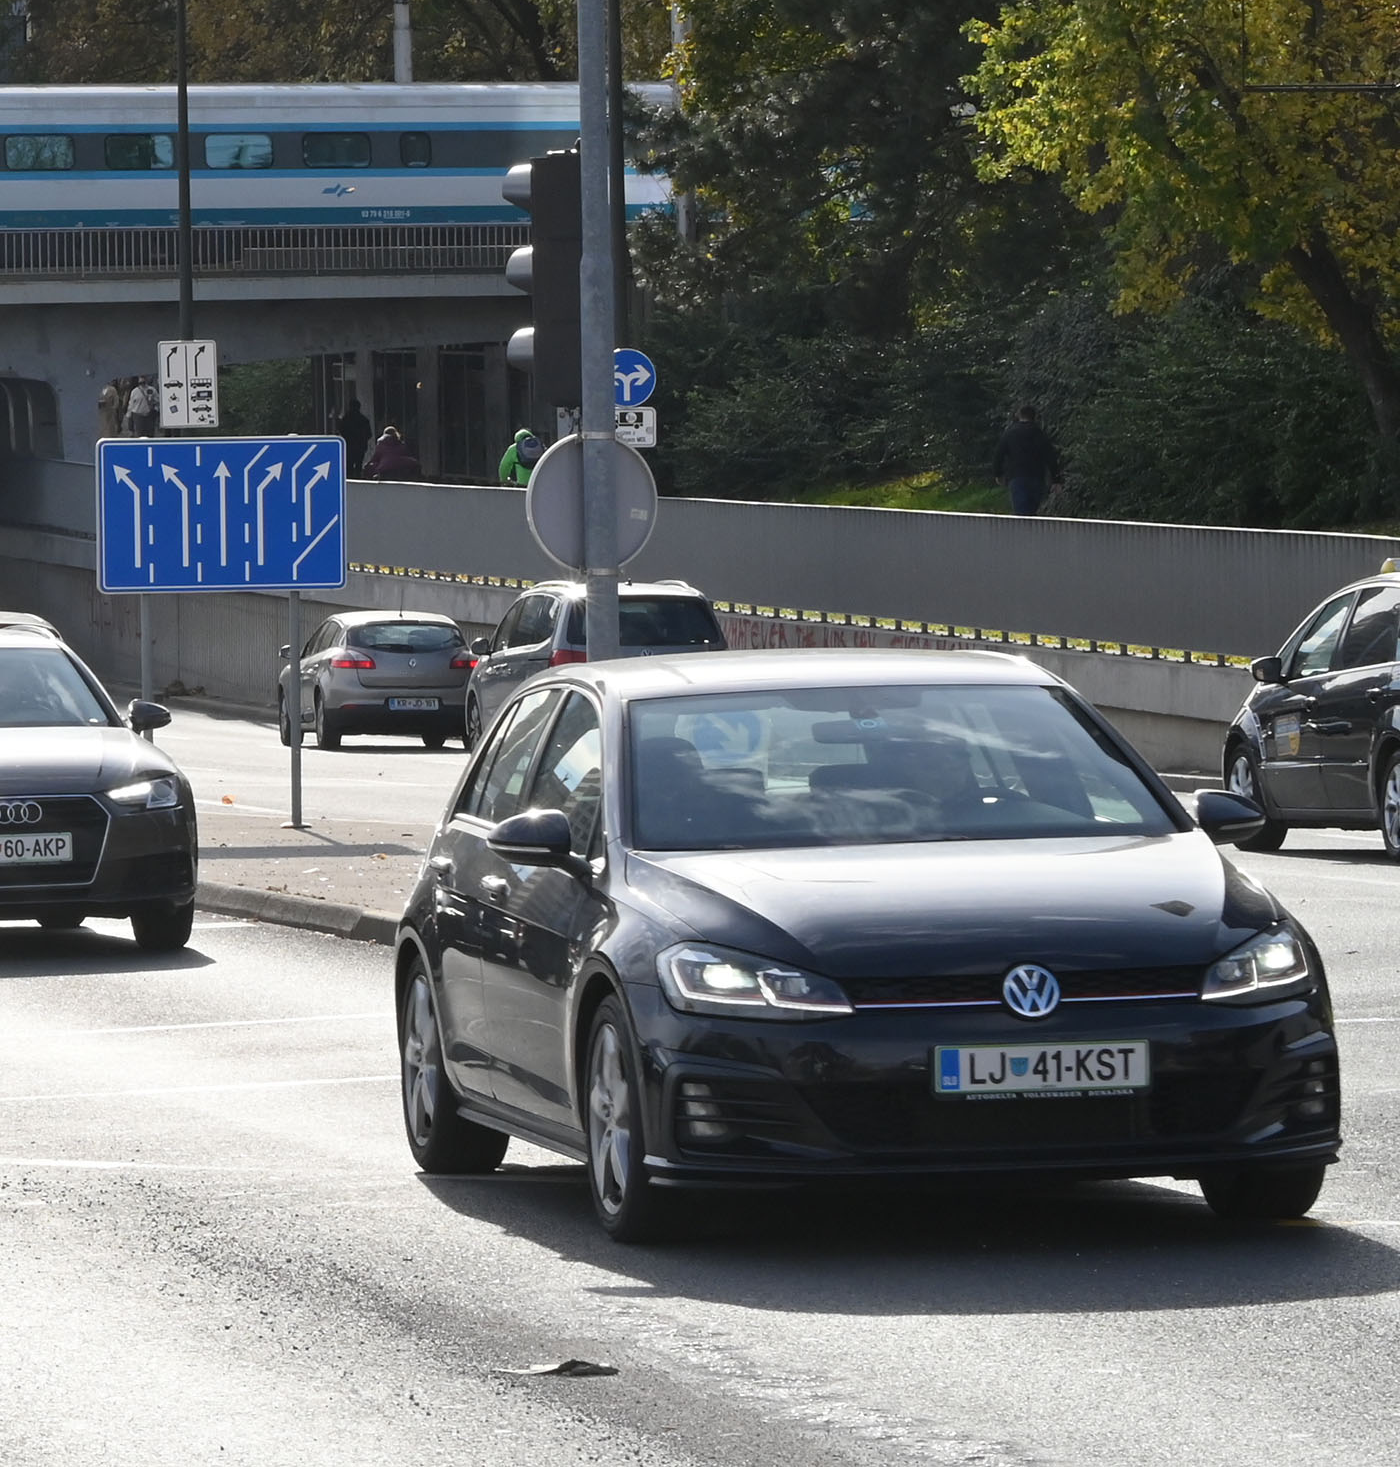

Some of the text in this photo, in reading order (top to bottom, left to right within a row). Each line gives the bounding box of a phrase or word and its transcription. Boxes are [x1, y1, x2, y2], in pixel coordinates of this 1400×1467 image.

[3, 837, 67, 859] 60-AKP
[969, 1047, 1136, 1085] LJ 41-KST
[1023, 1090, 1082, 1100] VOLKSWAGEN
